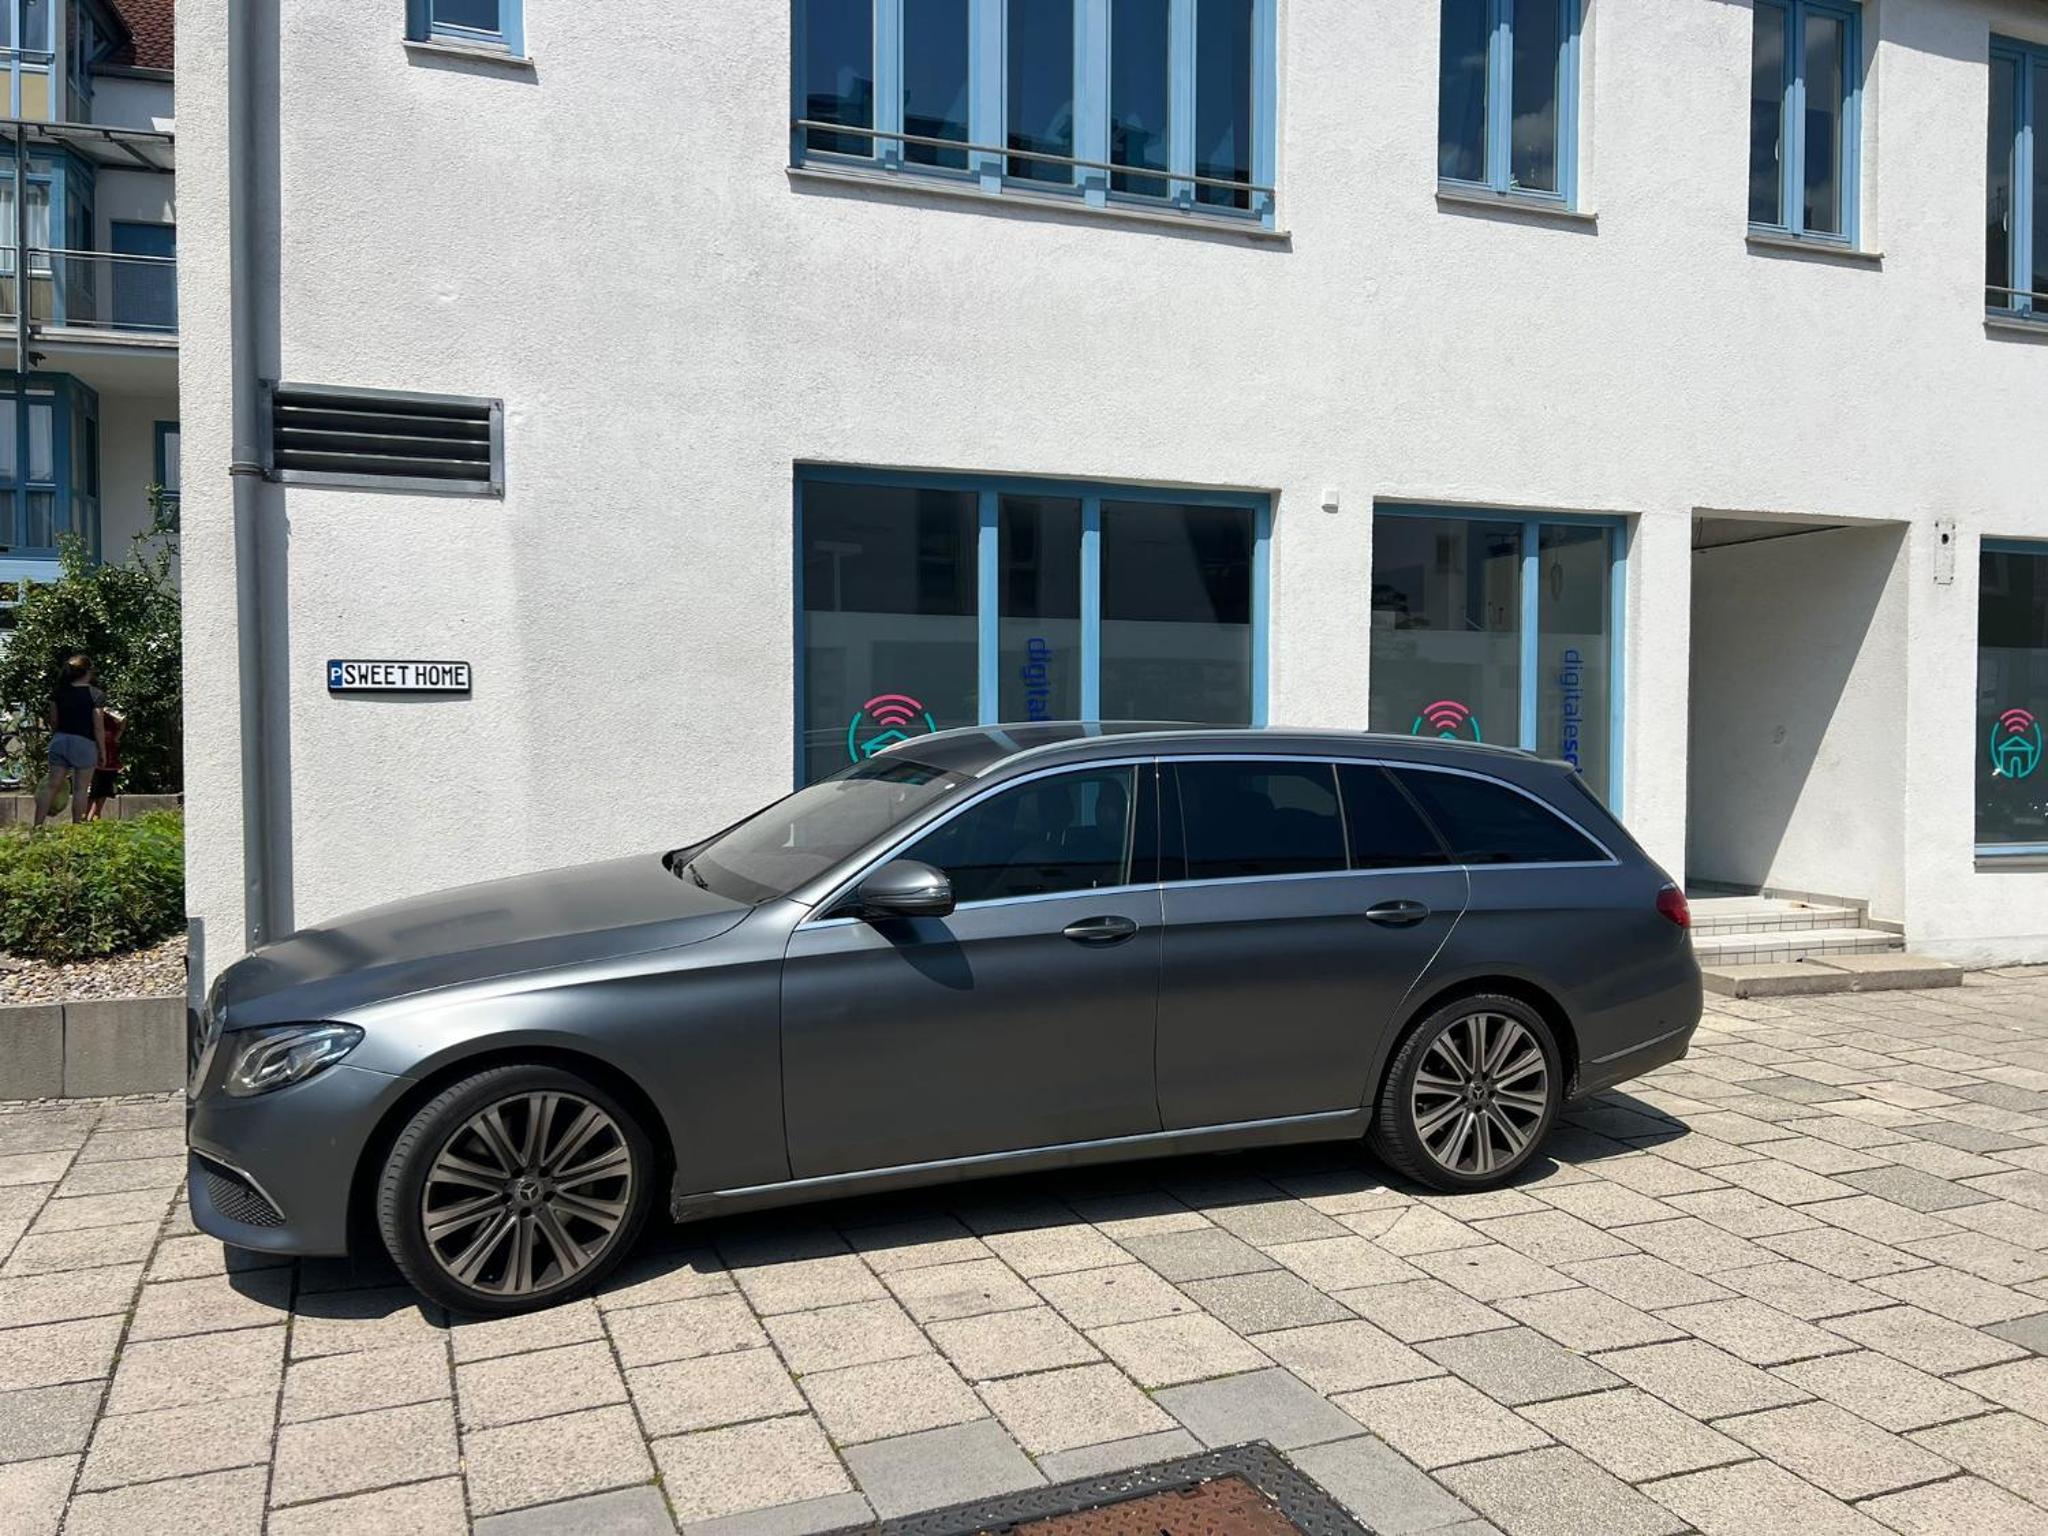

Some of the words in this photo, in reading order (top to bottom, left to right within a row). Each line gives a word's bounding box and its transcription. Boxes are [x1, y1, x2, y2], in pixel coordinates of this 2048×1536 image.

[331, 667, 342, 681] P
[344, 664, 409, 686] SWEET
[415, 665, 467, 686] HOME
[1560, 650, 1584, 773] digitalesc
